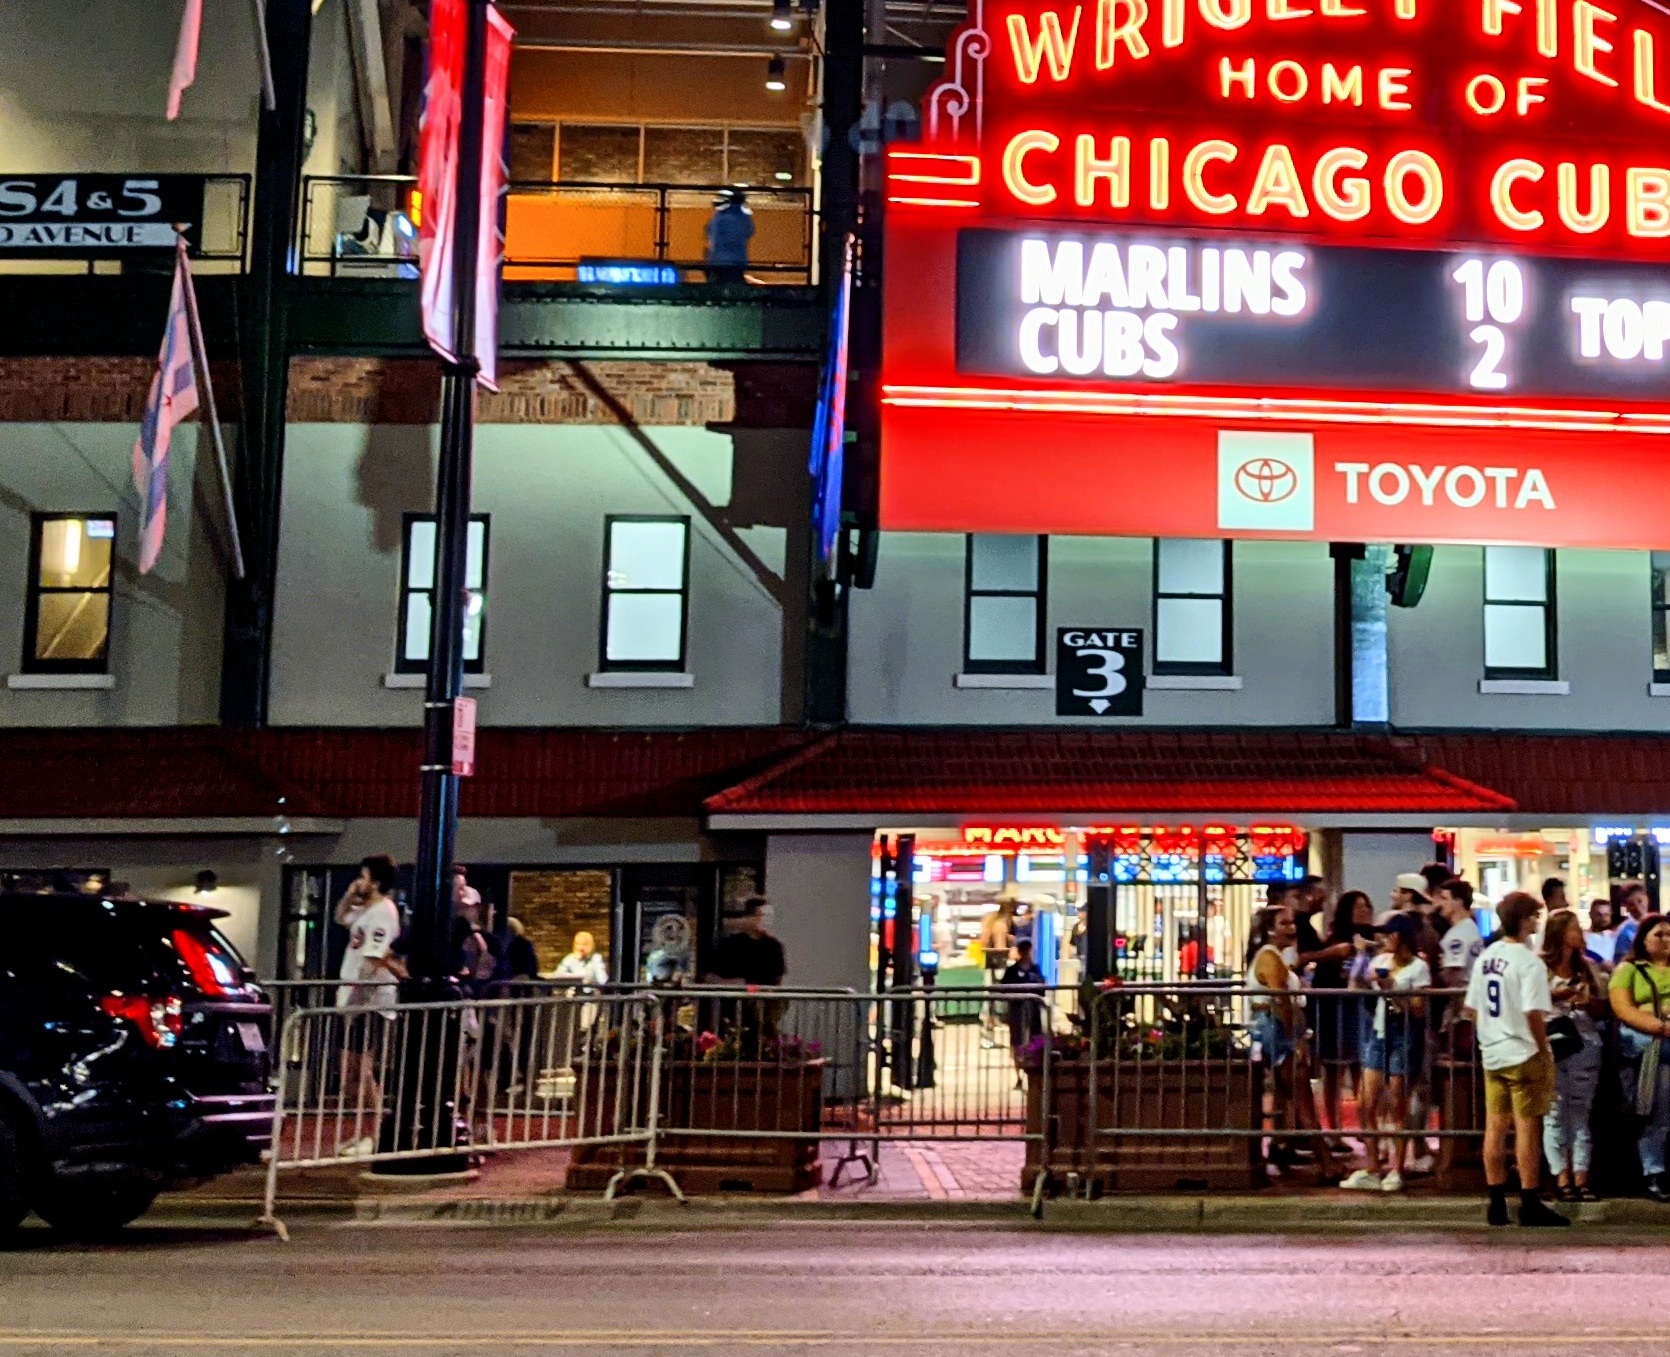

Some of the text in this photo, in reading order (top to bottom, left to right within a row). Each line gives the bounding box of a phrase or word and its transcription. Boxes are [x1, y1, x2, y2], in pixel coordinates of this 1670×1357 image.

[1219, 57, 1549, 116] HOME OF
[1002, 129, 1444, 225] CHICAGO
[26, 224, 144, 243] AVENUE
[1020, 239, 1307, 316] MARLINS
[1452, 259, 1524, 324] 10
[1018, 307, 1179, 378] CUBS
[1469, 324, 1507, 388] 2
[1334, 462, 1557, 509] TOYOTA
[1062, 631, 1138, 648] GATE
[1072, 648, 1127, 698] 3
[1486, 979, 1501, 1018] 9
